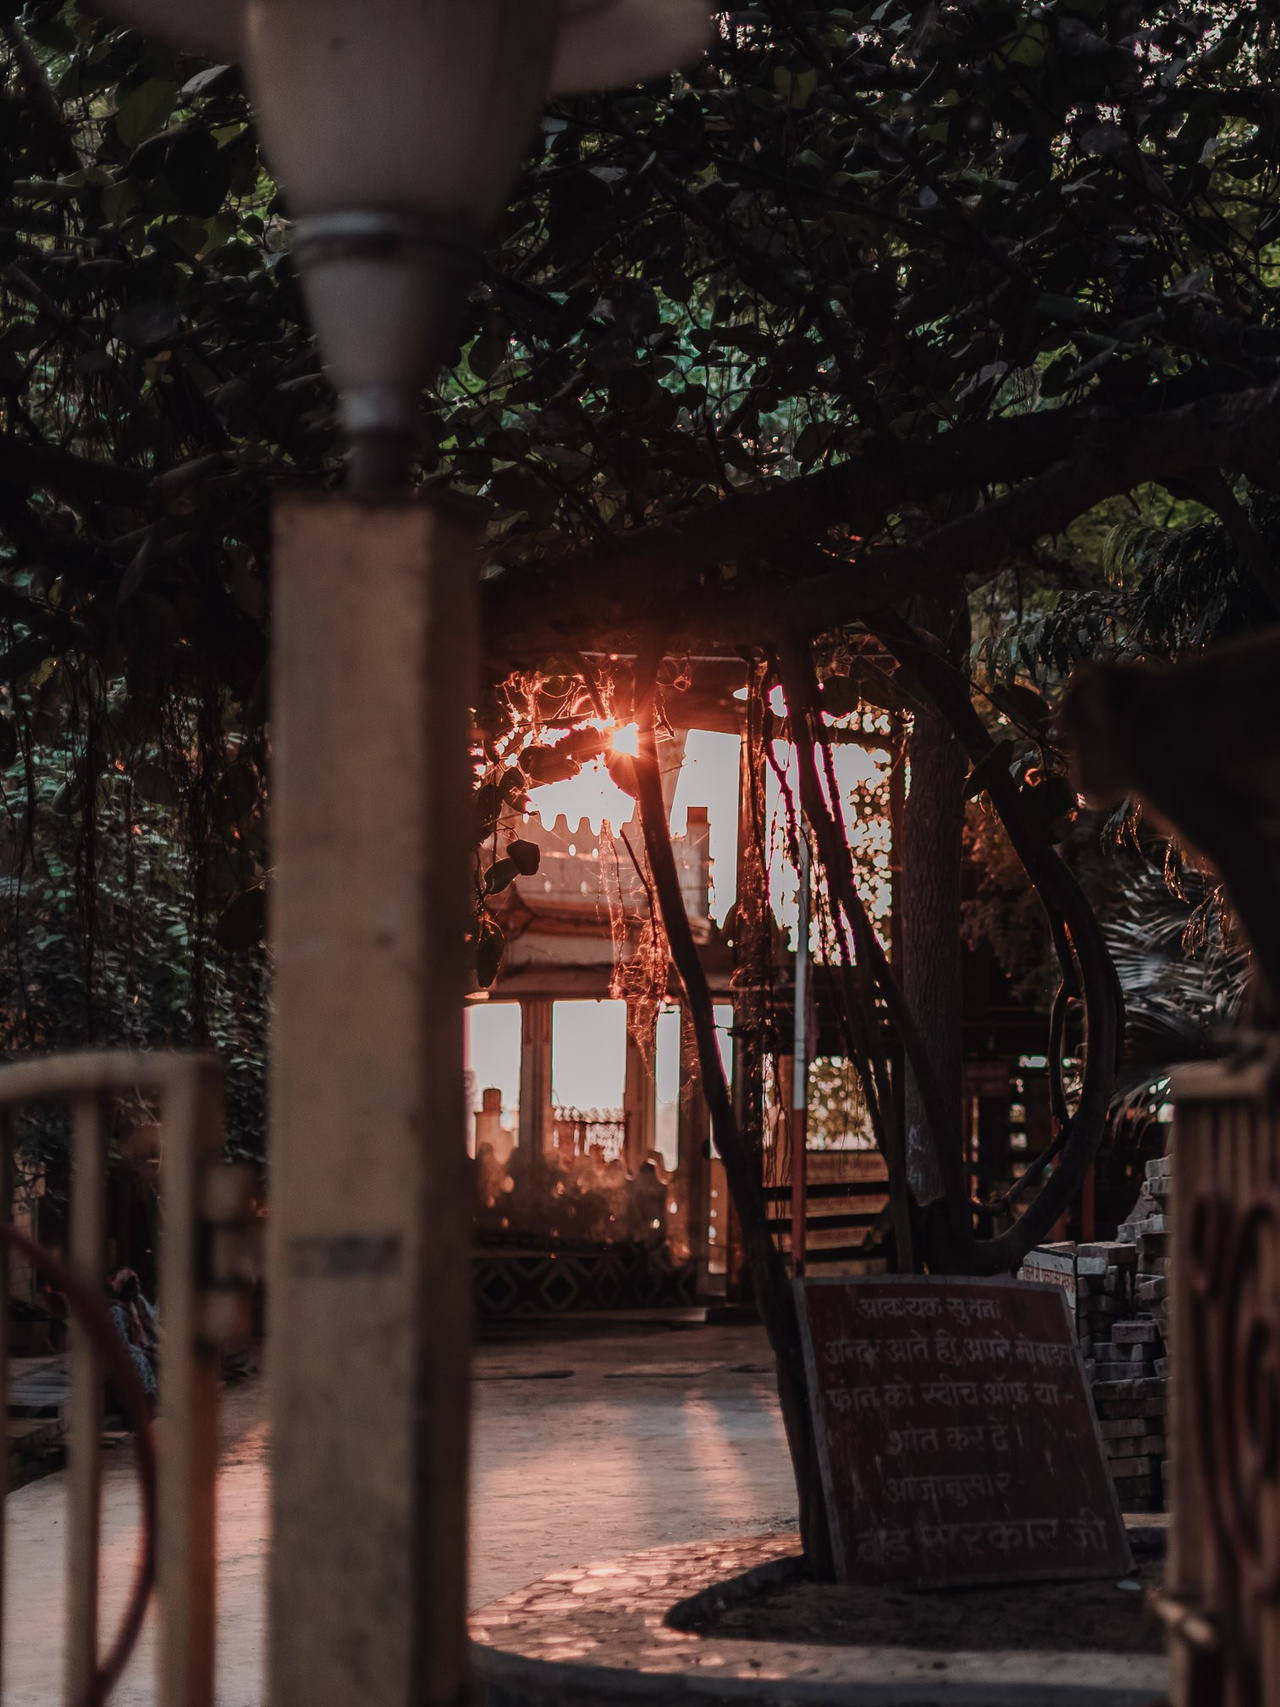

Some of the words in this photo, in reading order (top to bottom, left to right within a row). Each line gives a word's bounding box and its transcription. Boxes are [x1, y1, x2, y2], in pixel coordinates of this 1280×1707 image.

[887, 1330, 929, 1363] आते
[884, 1376, 915, 1409] को
[920, 1372, 980, 1408] स्वीच
[1032, 1382, 1060, 1406] या
[945, 1425, 986, 1452] कर
